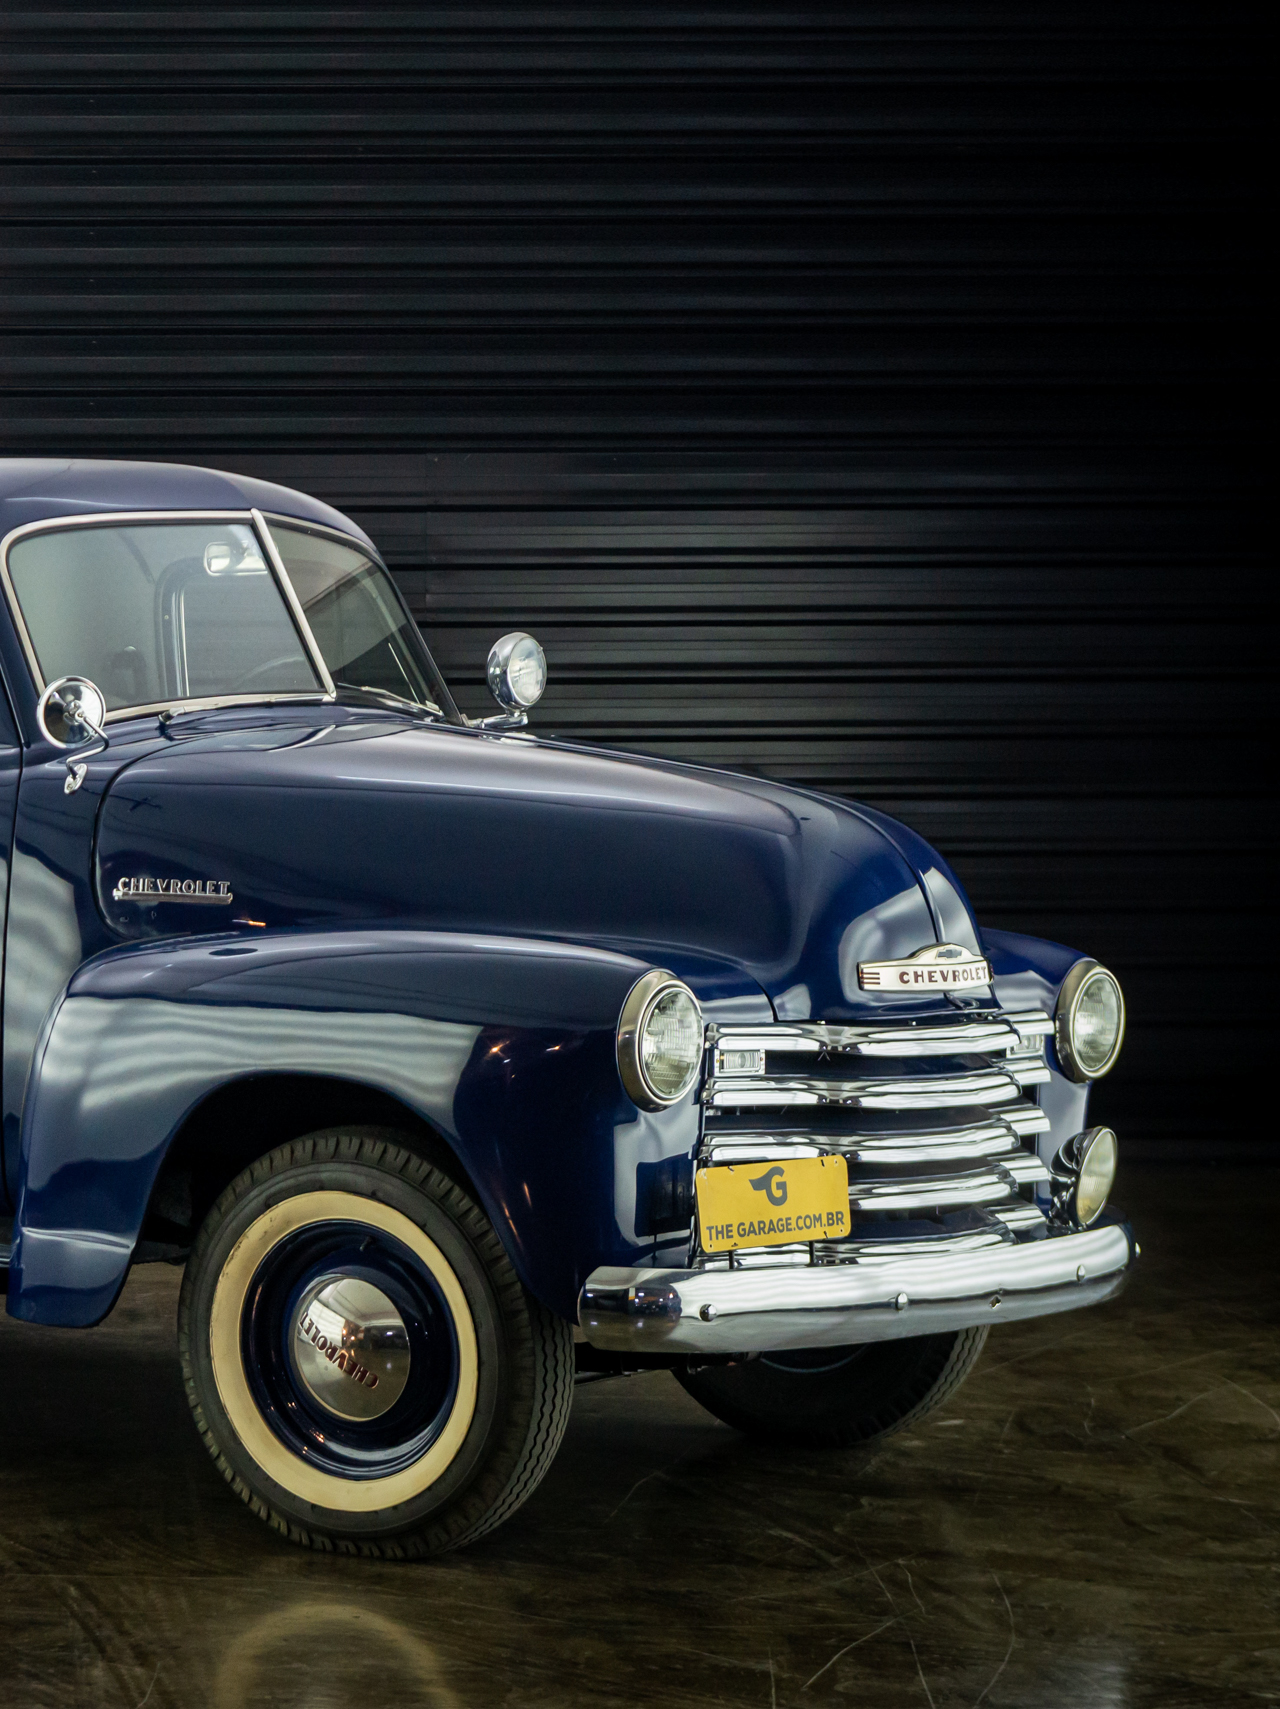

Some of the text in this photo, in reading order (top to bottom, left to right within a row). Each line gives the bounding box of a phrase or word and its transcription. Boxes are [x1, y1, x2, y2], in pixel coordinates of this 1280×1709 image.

[118, 877, 231, 895] CHEVROLET
[898, 965, 988, 985] CHEVROLET
[706, 1211, 845, 1241] THE GARAGE.COM.BR
[297, 1312, 380, 1389] CHEVROLET
